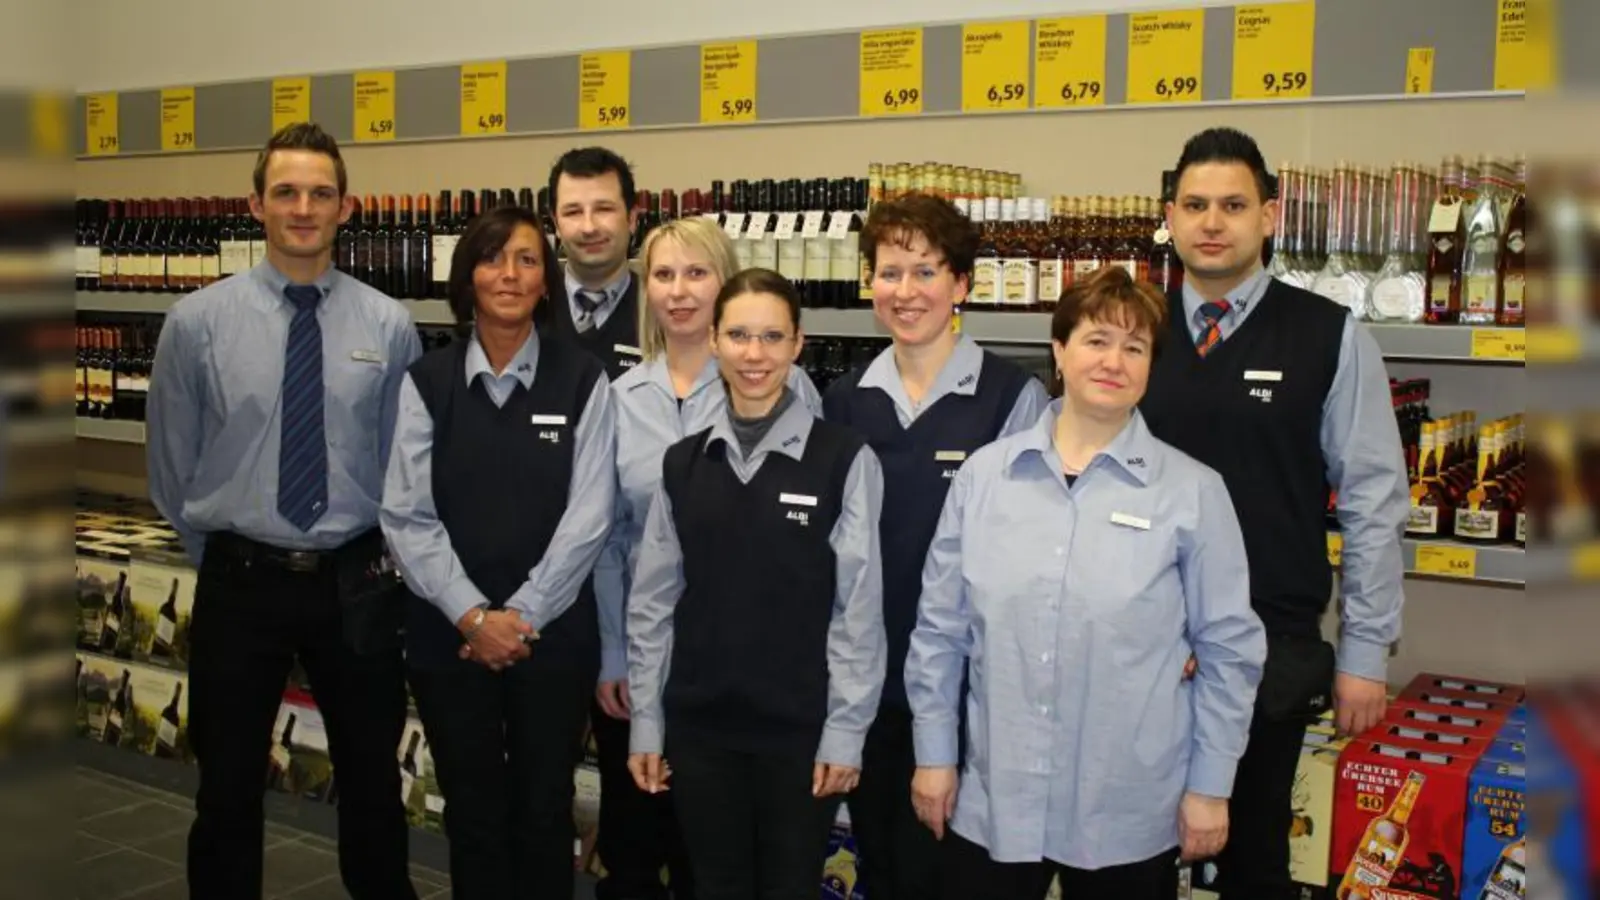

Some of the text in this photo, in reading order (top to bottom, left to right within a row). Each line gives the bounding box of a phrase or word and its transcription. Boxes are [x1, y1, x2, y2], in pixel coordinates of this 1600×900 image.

[1155, 77, 1197, 98] 6,99
[1263, 72, 1307, 94] 9,59
[884, 87, 919, 108] 6,99
[987, 83, 1024, 104] 6,59
[1061, 81, 1101, 103] 6,79
[598, 106, 627, 125] 5,99
[722, 98, 753, 117] 5,99
[478, 114, 503, 129] 4,99
[1249, 386, 1273, 398] ALDI
[539, 430, 559, 440] ALDI
[785, 509, 809, 521] ALDI
[1346, 761, 1398, 777] ECHTER
[1356, 781, 1384, 794] RUM
[1359, 795, 1382, 809] 40
[1491, 820, 1516, 837] 54
